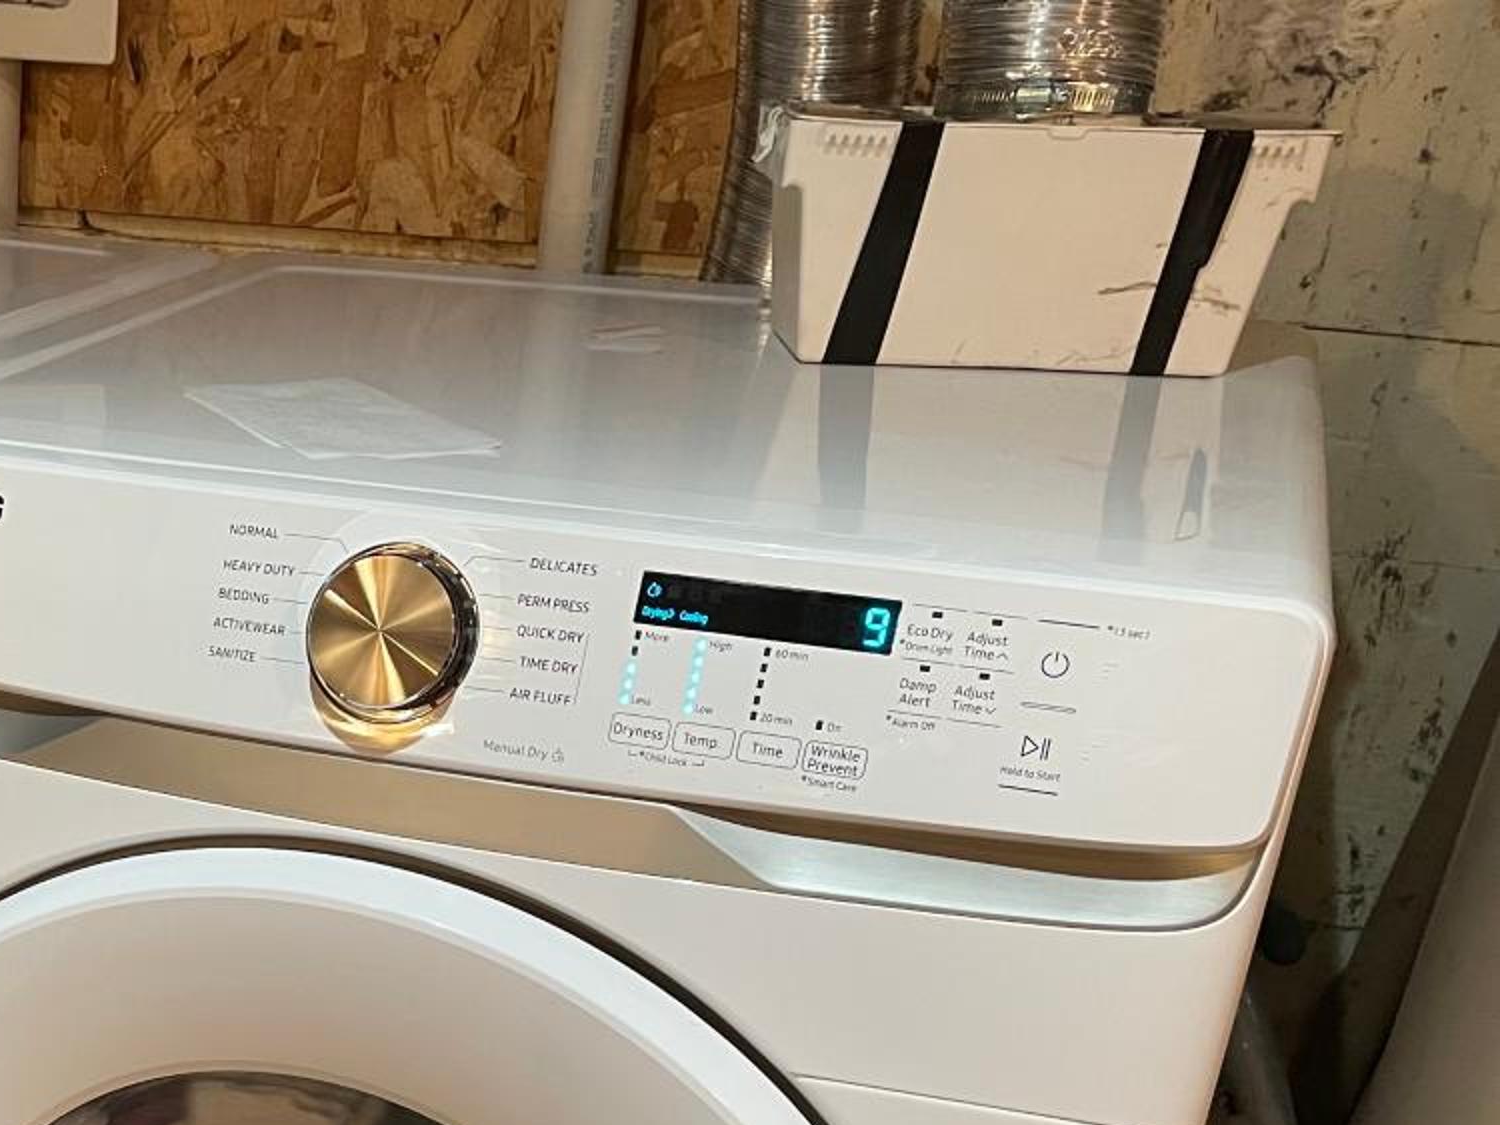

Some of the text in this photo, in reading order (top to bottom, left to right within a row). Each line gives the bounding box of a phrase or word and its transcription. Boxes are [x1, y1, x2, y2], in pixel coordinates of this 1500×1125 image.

[229, 524, 279, 540] NORMAL
[223, 559, 295, 577] HEAVY DUTY
[529, 557, 598, 577] DELICATES
[218, 587, 270, 605] BEDDING
[517, 593, 590, 614] PERM PRESS
[213, 617, 286, 636] ACTIVEWEAR
[517, 624, 584, 644] QUICK DRY
[863, 607, 890, 647] 9
[907, 623, 954, 643] Eco Dry
[967, 631, 1009, 647] Adjust
[208, 645, 257, 663] SANITIZE
[964, 645, 995, 660] Time
[520, 655, 579, 675] TIME DRY
[899, 677, 937, 695] Damp
[954, 685, 996, 701] Adjust
[509, 687, 572, 706] AIR FLUFF
[899, 693, 931, 708] Alert
[952, 699, 982, 715] Time
[613, 721, 663, 741] Dryness
[483, 739, 548, 762] Manual Dry
[753, 741, 784, 759] Time
[810, 744, 861, 763] Wrinkle
[807, 758, 858, 777] Prevent
